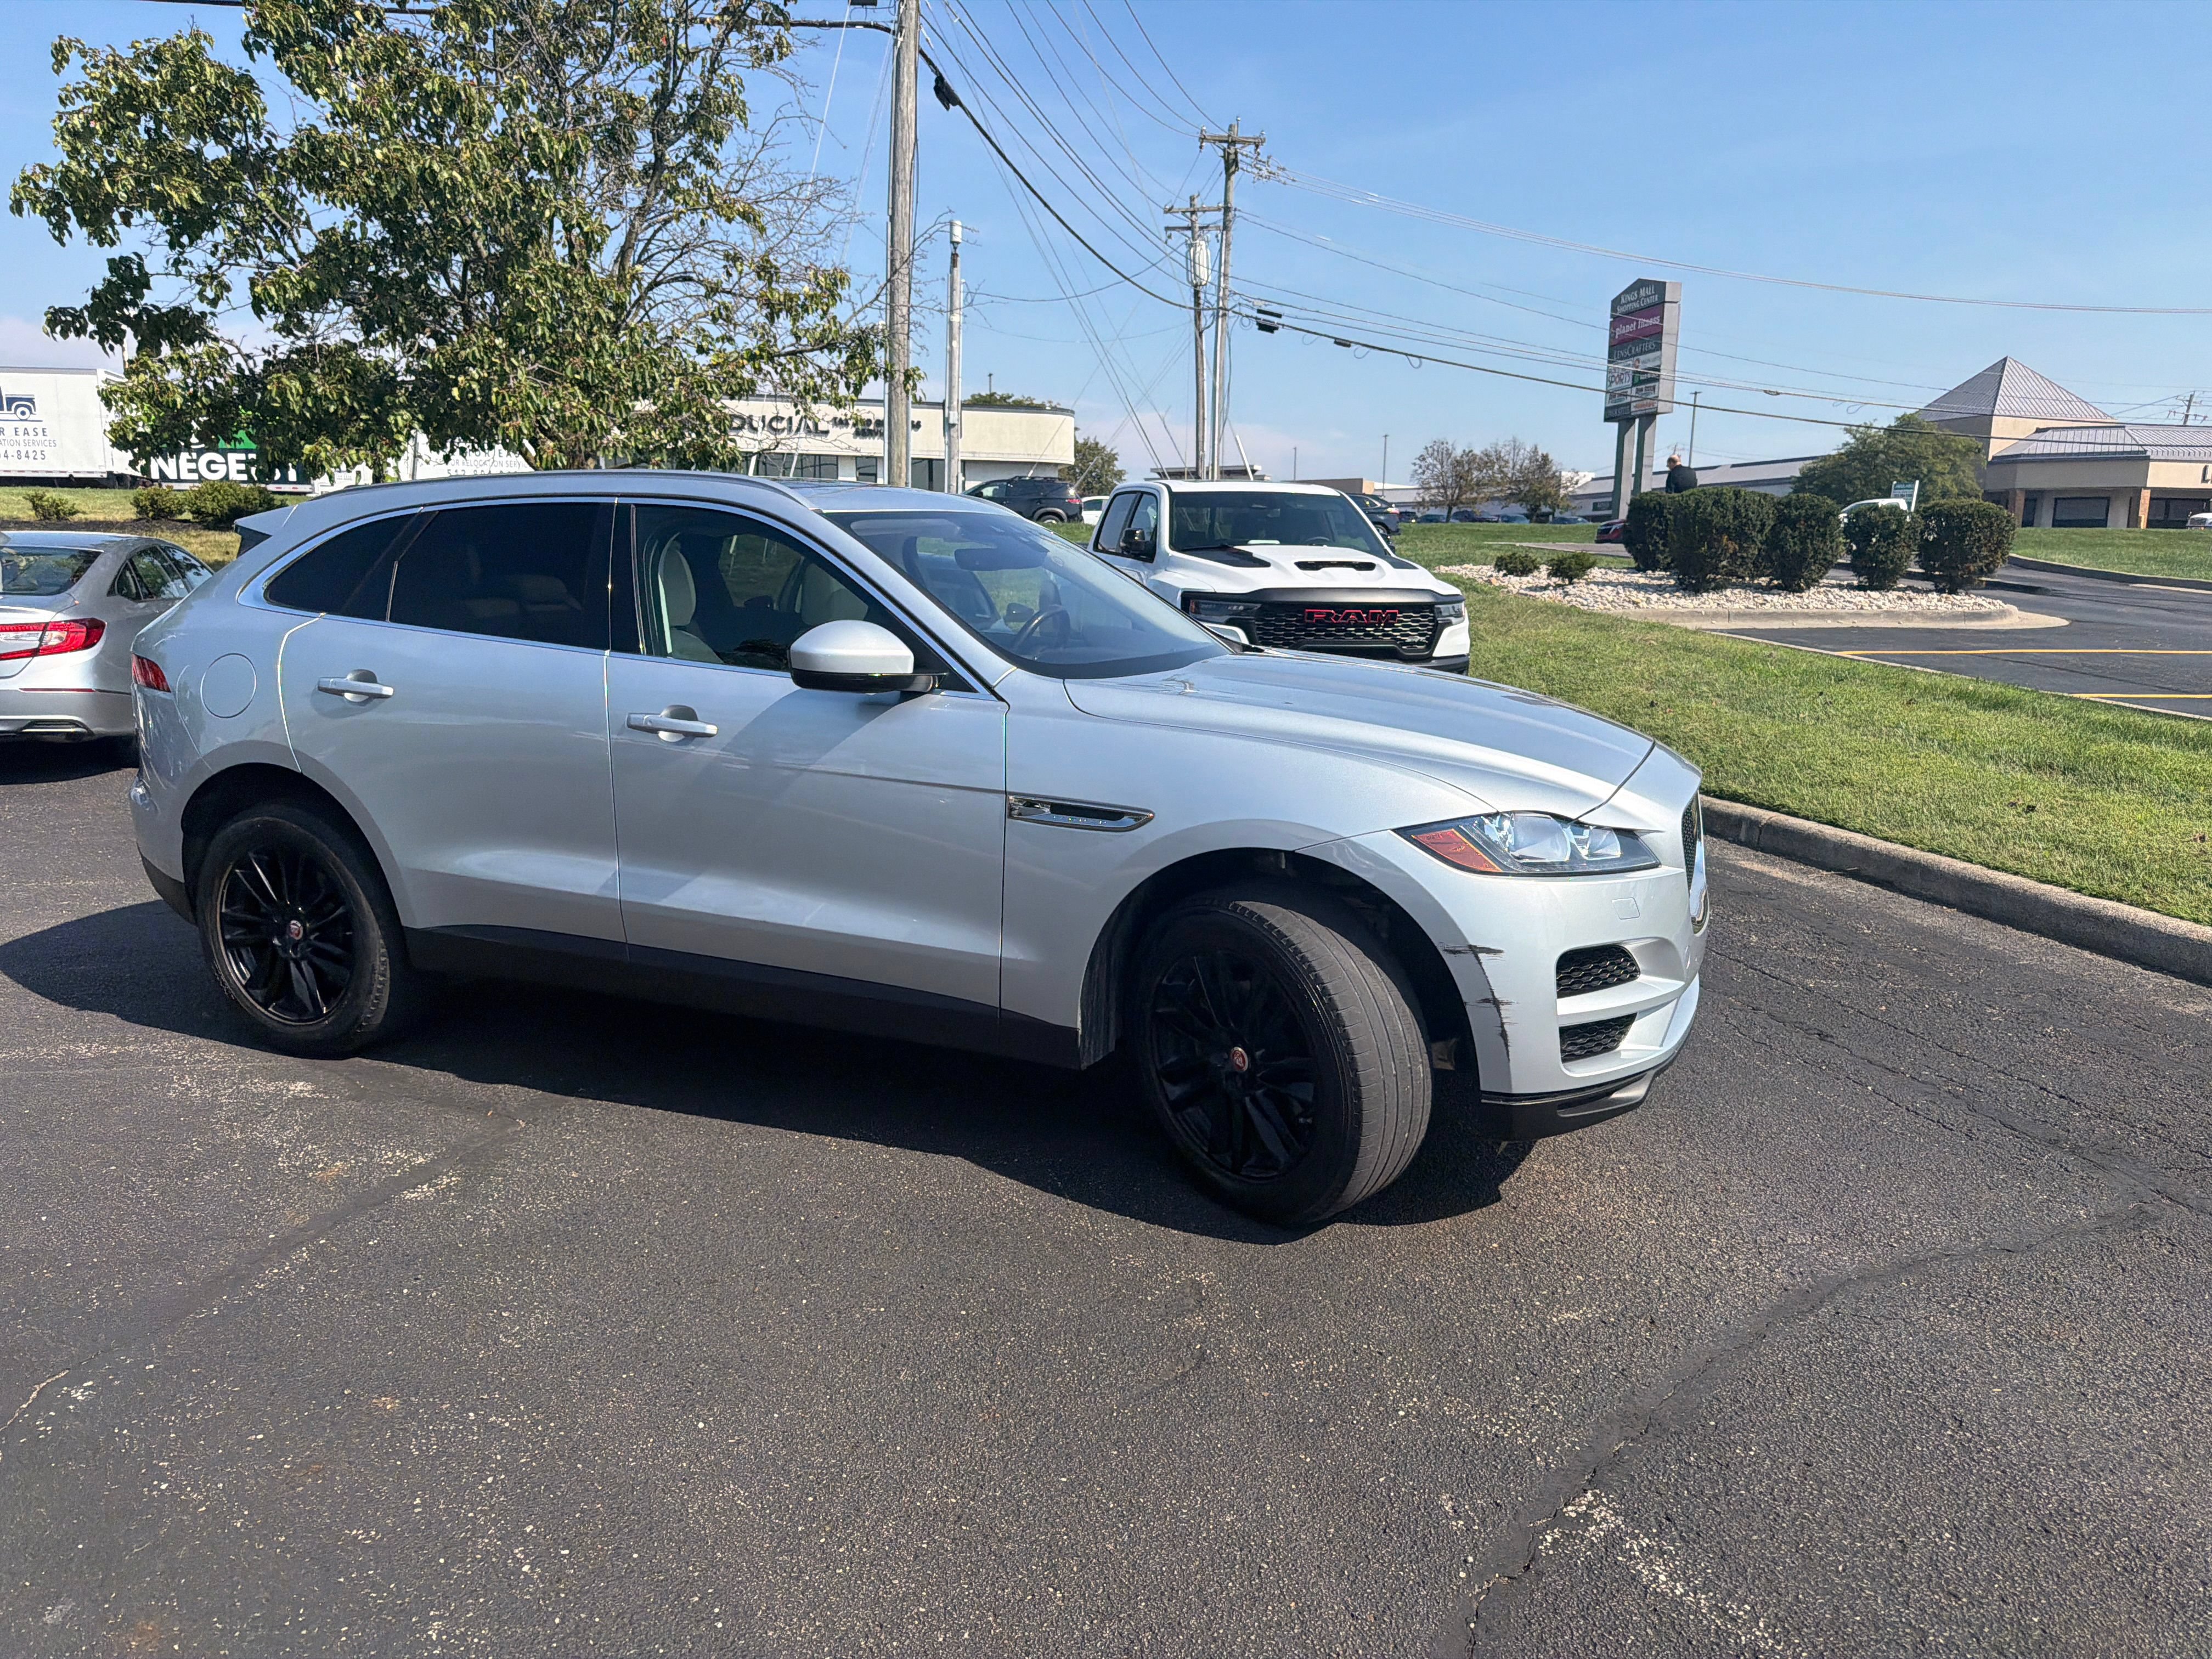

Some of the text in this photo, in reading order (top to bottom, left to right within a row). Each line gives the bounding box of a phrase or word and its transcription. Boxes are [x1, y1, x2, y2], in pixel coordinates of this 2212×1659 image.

[1621, 285, 1655, 304] KINGS MALL
[1617, 295, 1658, 313] SHOPPING CENTER
[1616, 320, 1637, 338] planet
[14, 427, 48, 437] EASE
[23, 439, 57, 447] SERVICES
[0, 449, 46, 460] 4-8425
[1305, 609, 1399, 623] RAM
